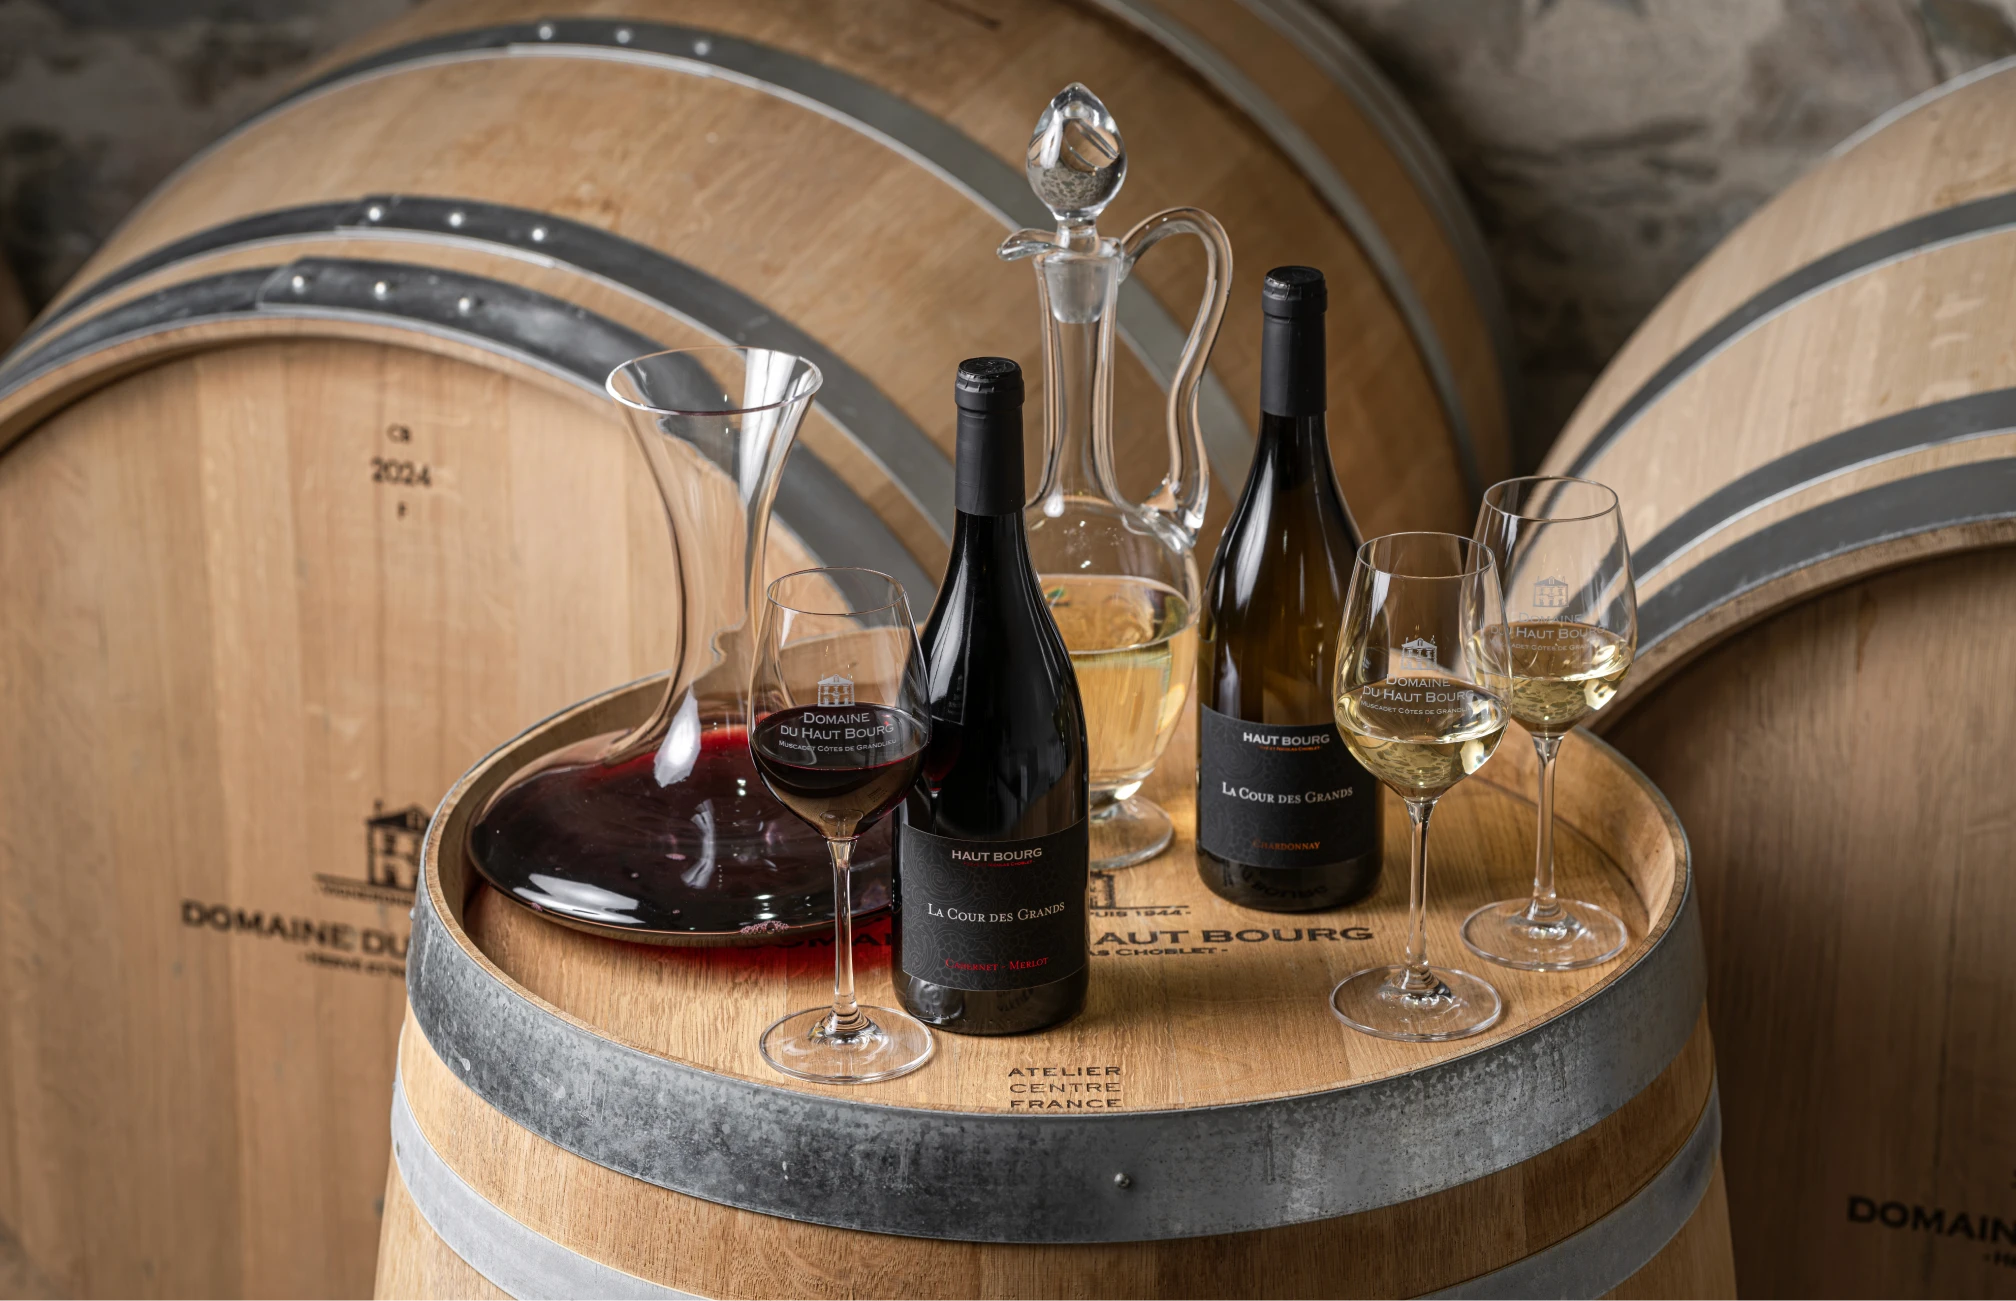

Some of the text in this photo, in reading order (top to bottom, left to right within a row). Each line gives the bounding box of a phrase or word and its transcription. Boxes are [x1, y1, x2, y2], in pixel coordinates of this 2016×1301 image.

[370, 457, 432, 487] 2024
[780, 725, 798, 737] DU
[1243, 732, 1330, 746] HAUT BOURG
[951, 848, 1042, 862] HAUT BOURG
[181, 900, 355, 951] DOMAINE
[1094, 927, 1375, 945] AUT BOURG
[1008, 1066, 1121, 1077] ATELIER
[1010, 1082, 1121, 1093] CENTRE
[1011, 1098, 1122, 1109] FRANCE
[1847, 1195, 2016, 1246] DOMAIN
